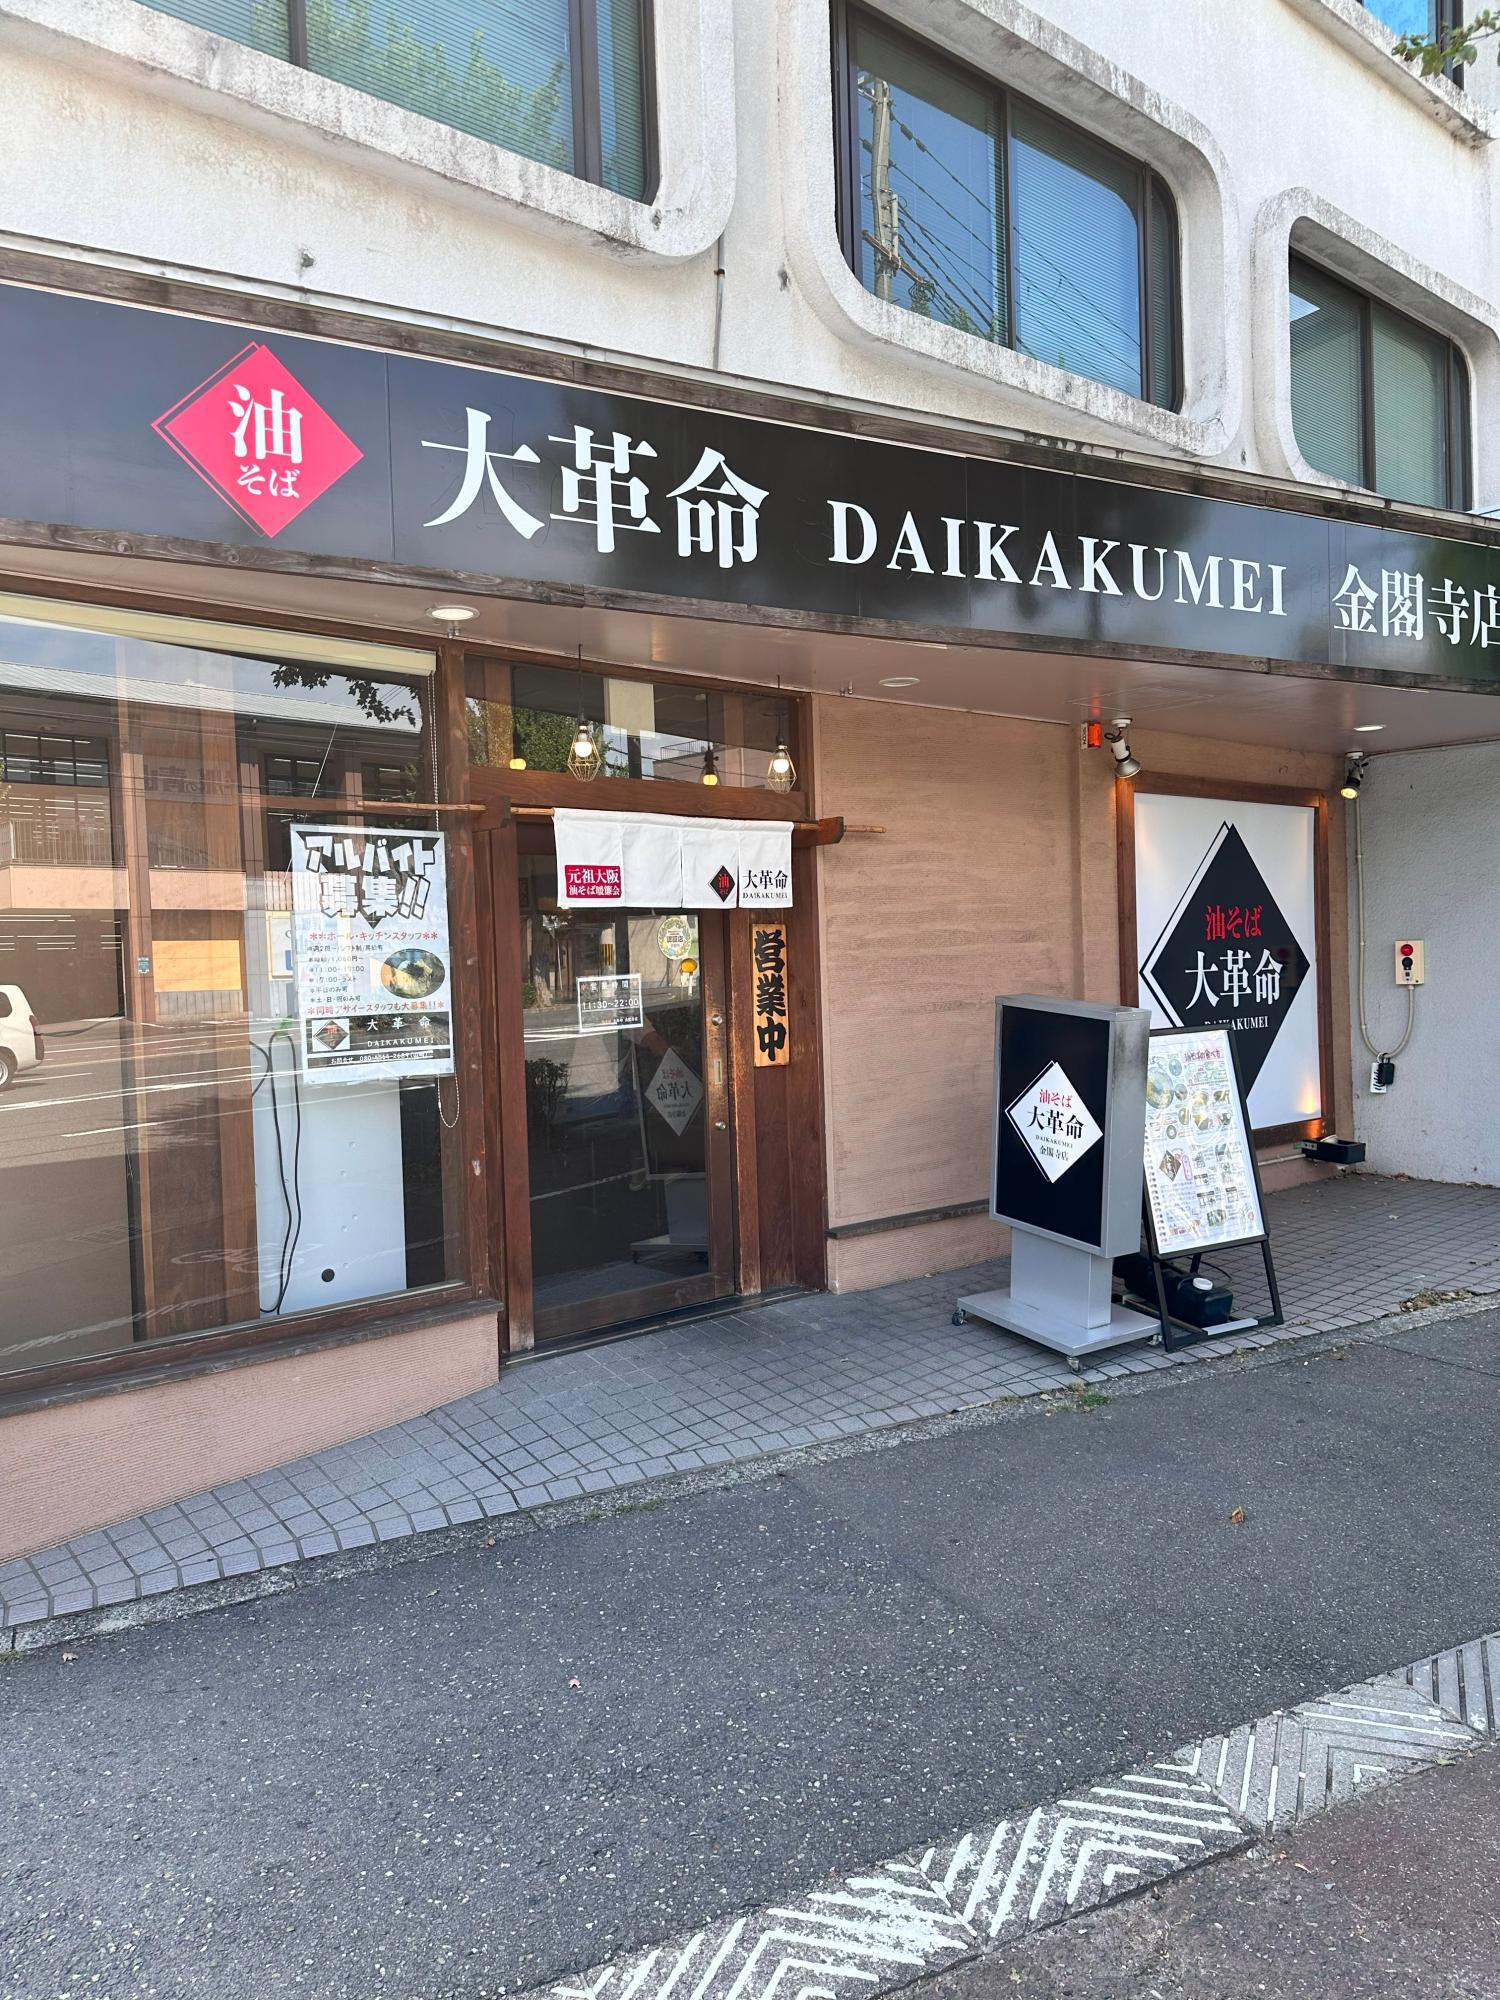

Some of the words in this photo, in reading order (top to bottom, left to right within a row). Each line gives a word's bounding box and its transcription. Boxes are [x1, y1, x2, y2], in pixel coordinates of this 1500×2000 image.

[228, 384, 303, 464] 油
[236, 464, 301, 498] そば
[420, 407, 770, 569] 大革命
[826, 500, 1288, 616] DAIKAKUMEI
[1332, 563, 1500, 648] 金閣寺店
[304, 836, 436, 875] アルバイト
[568, 868, 620, 884] 元祖大阪
[719, 873, 730, 888] 油
[742, 870, 788, 890] 大革命
[569, 885, 620, 896] 油そば暖簾会
[1205, 904, 1263, 941] 油そば
[1184, 948, 1284, 1010] 大革命
[754, 930, 787, 1062] 営業中
[367, 1037, 434, 1047] DAIKAKUMEI
[1039, 1088, 1073, 1109] 油そば
[1026, 1105, 1085, 1140] 大革命
[1035, 1135, 1074, 1149] DAIKAKUMEI
[1039, 1145, 1070, 1162] 金閣寺店
